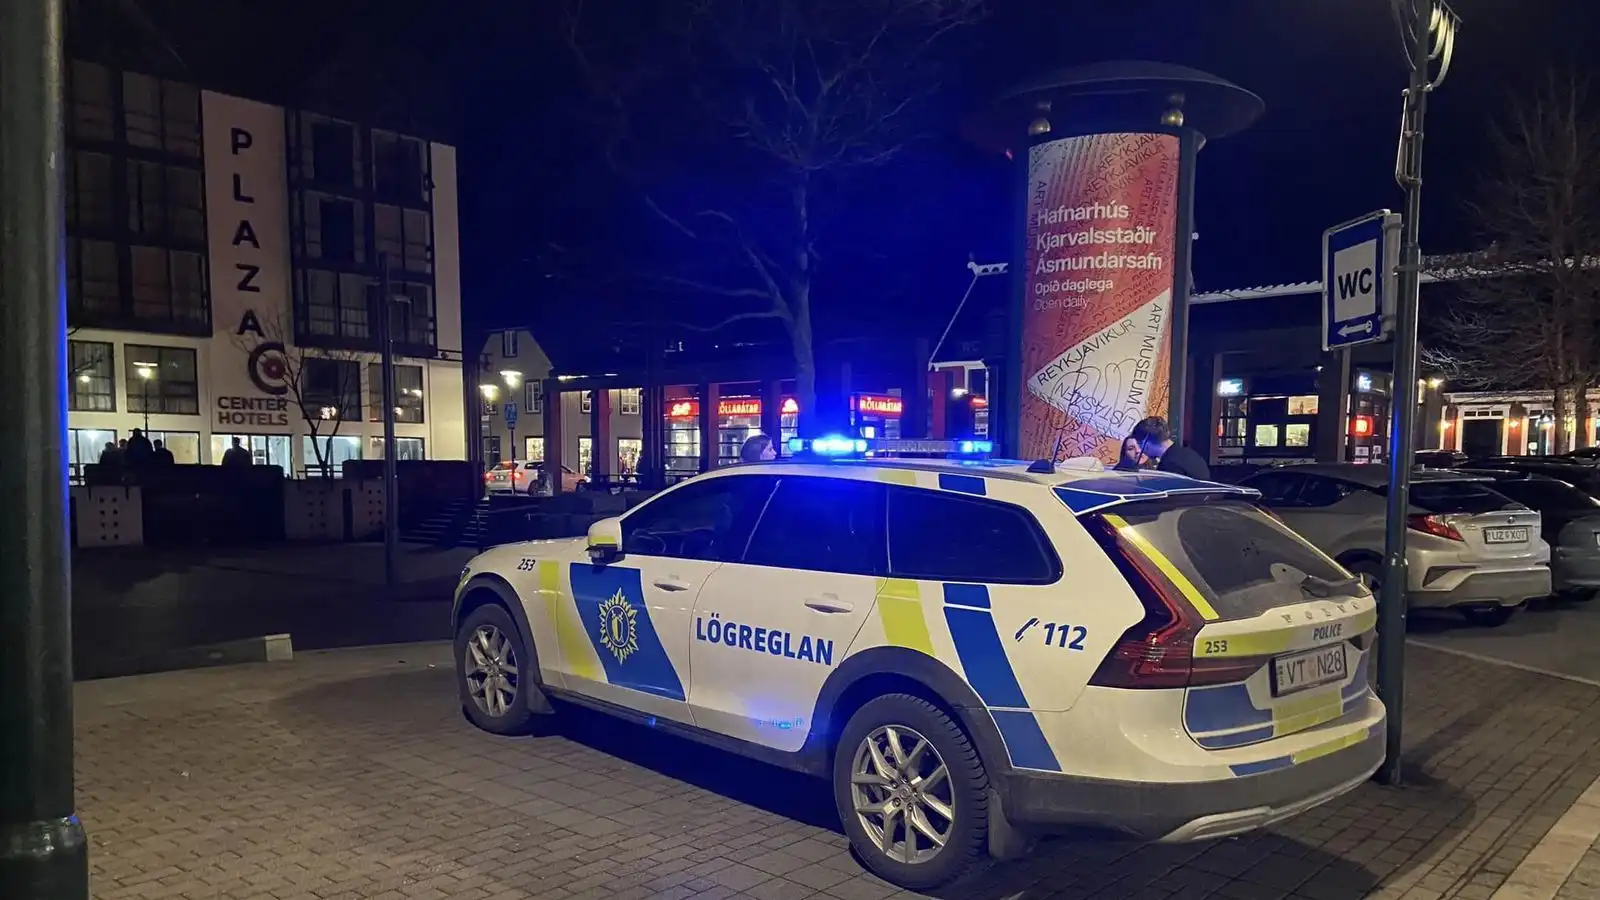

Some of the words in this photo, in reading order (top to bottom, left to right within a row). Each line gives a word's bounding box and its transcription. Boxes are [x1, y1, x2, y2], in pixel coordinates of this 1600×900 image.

[1037, 200, 1130, 227] Hafnarhús
[231, 127, 264, 337] PLAZA
[1036, 226, 1157, 252] Kjarvalsstaðir
[1035, 251, 1162, 276] Ásmundarsafn
[1034, 280, 1060, 297] Opið
[1061, 278, 1114, 293] daglega
[1337, 267, 1373, 300] WC
[1034, 298, 1061, 312] Open
[1063, 295, 1089, 310] daily
[1148, 303, 1163, 332] ART
[1037, 318, 1136, 386] REYKJAVIKUR
[1127, 335, 1156, 404] MUSEUM
[217, 396, 288, 412] CENTER
[218, 411, 288, 426] HOTELS
[517, 558, 536, 571] 253
[696, 612, 834, 666] LÖGREGLAN
[1044, 622, 1087, 650] 112
[1313, 624, 1342, 640] POLICE
[1205, 640, 1228, 654] 253
[1287, 659, 1306, 685] VT
[1317, 651, 1342, 677] N28
